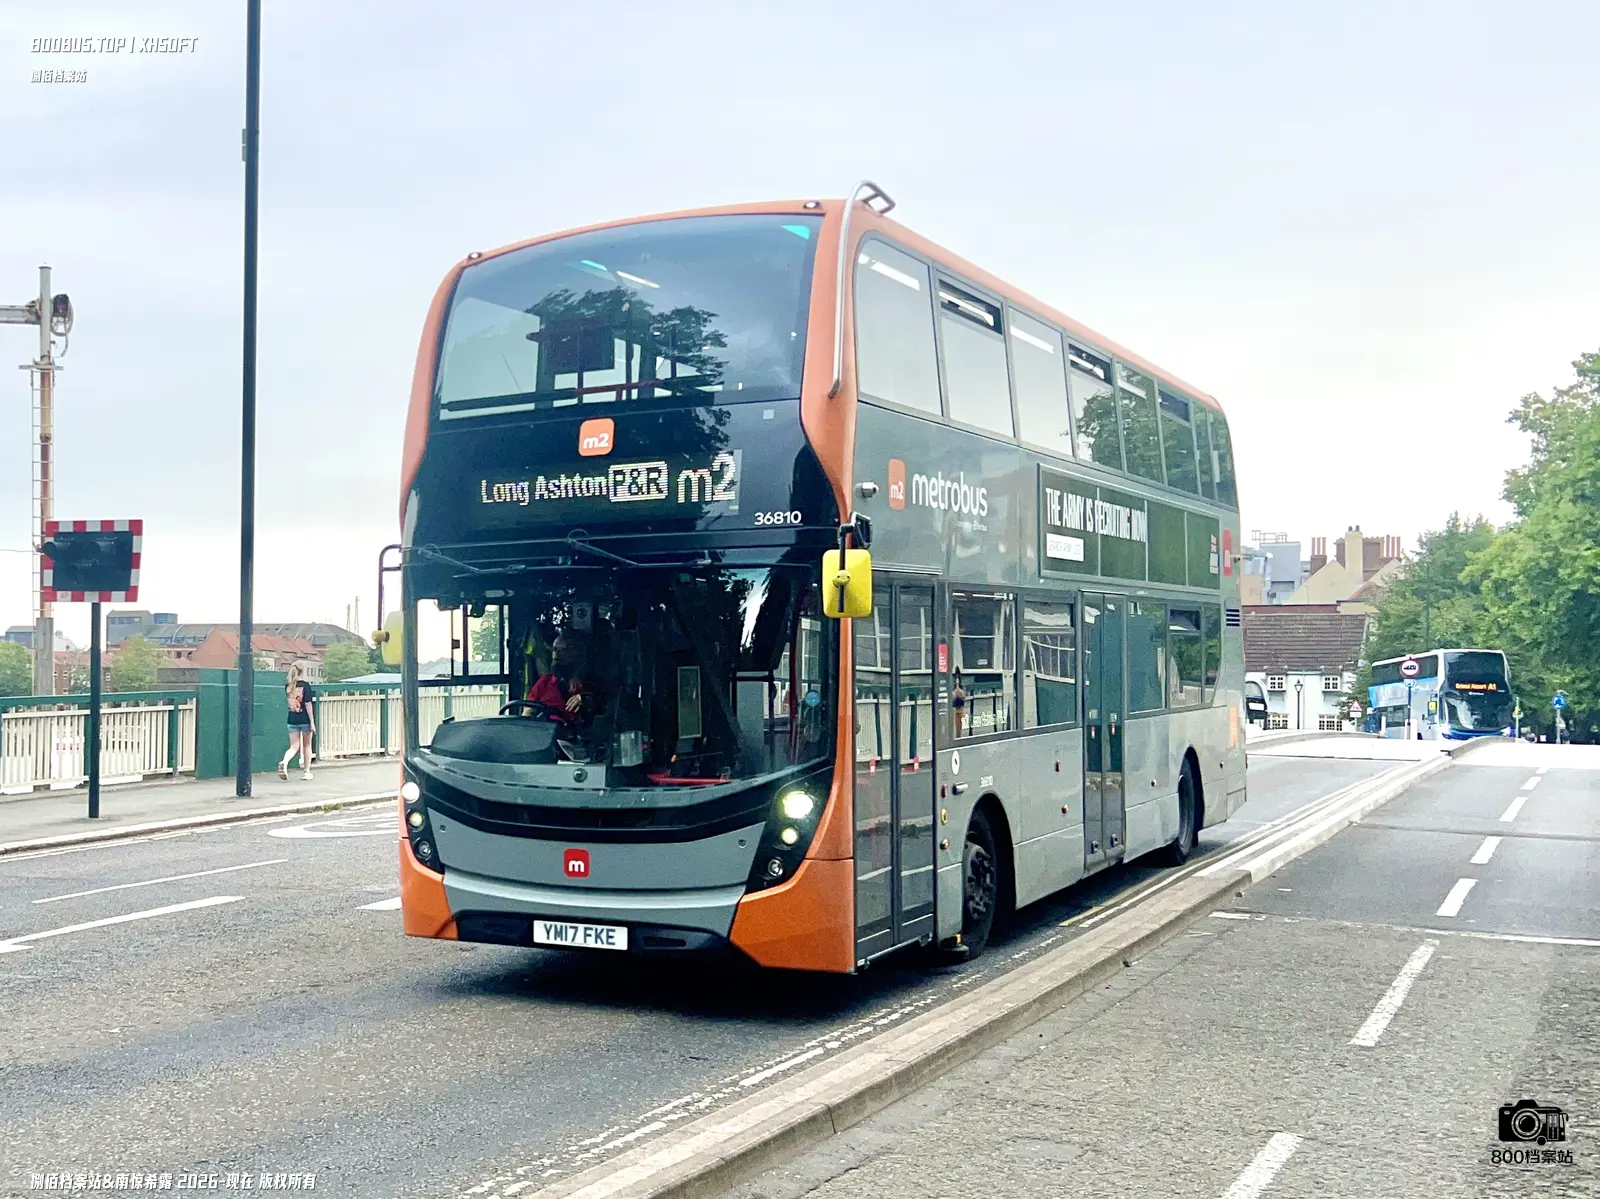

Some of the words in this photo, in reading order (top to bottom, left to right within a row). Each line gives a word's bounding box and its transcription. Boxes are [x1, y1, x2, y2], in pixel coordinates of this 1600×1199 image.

[583, 431, 609, 449] m2
[481, 479, 530, 506] Long
[535, 473, 608, 500] Ashton
[677, 451, 736, 503] m2
[890, 481, 904, 500] m2
[912, 471, 988, 517] metrobus
[754, 510, 802, 525] 36810
[1046, 488, 1061, 526] THE
[1063, 492, 1084, 531] ARMY
[1086, 498, 1094, 532] IS
[568, 860, 585, 873] m
[544, 923, 579, 944] YM17
[583, 927, 616, 946] FKE
